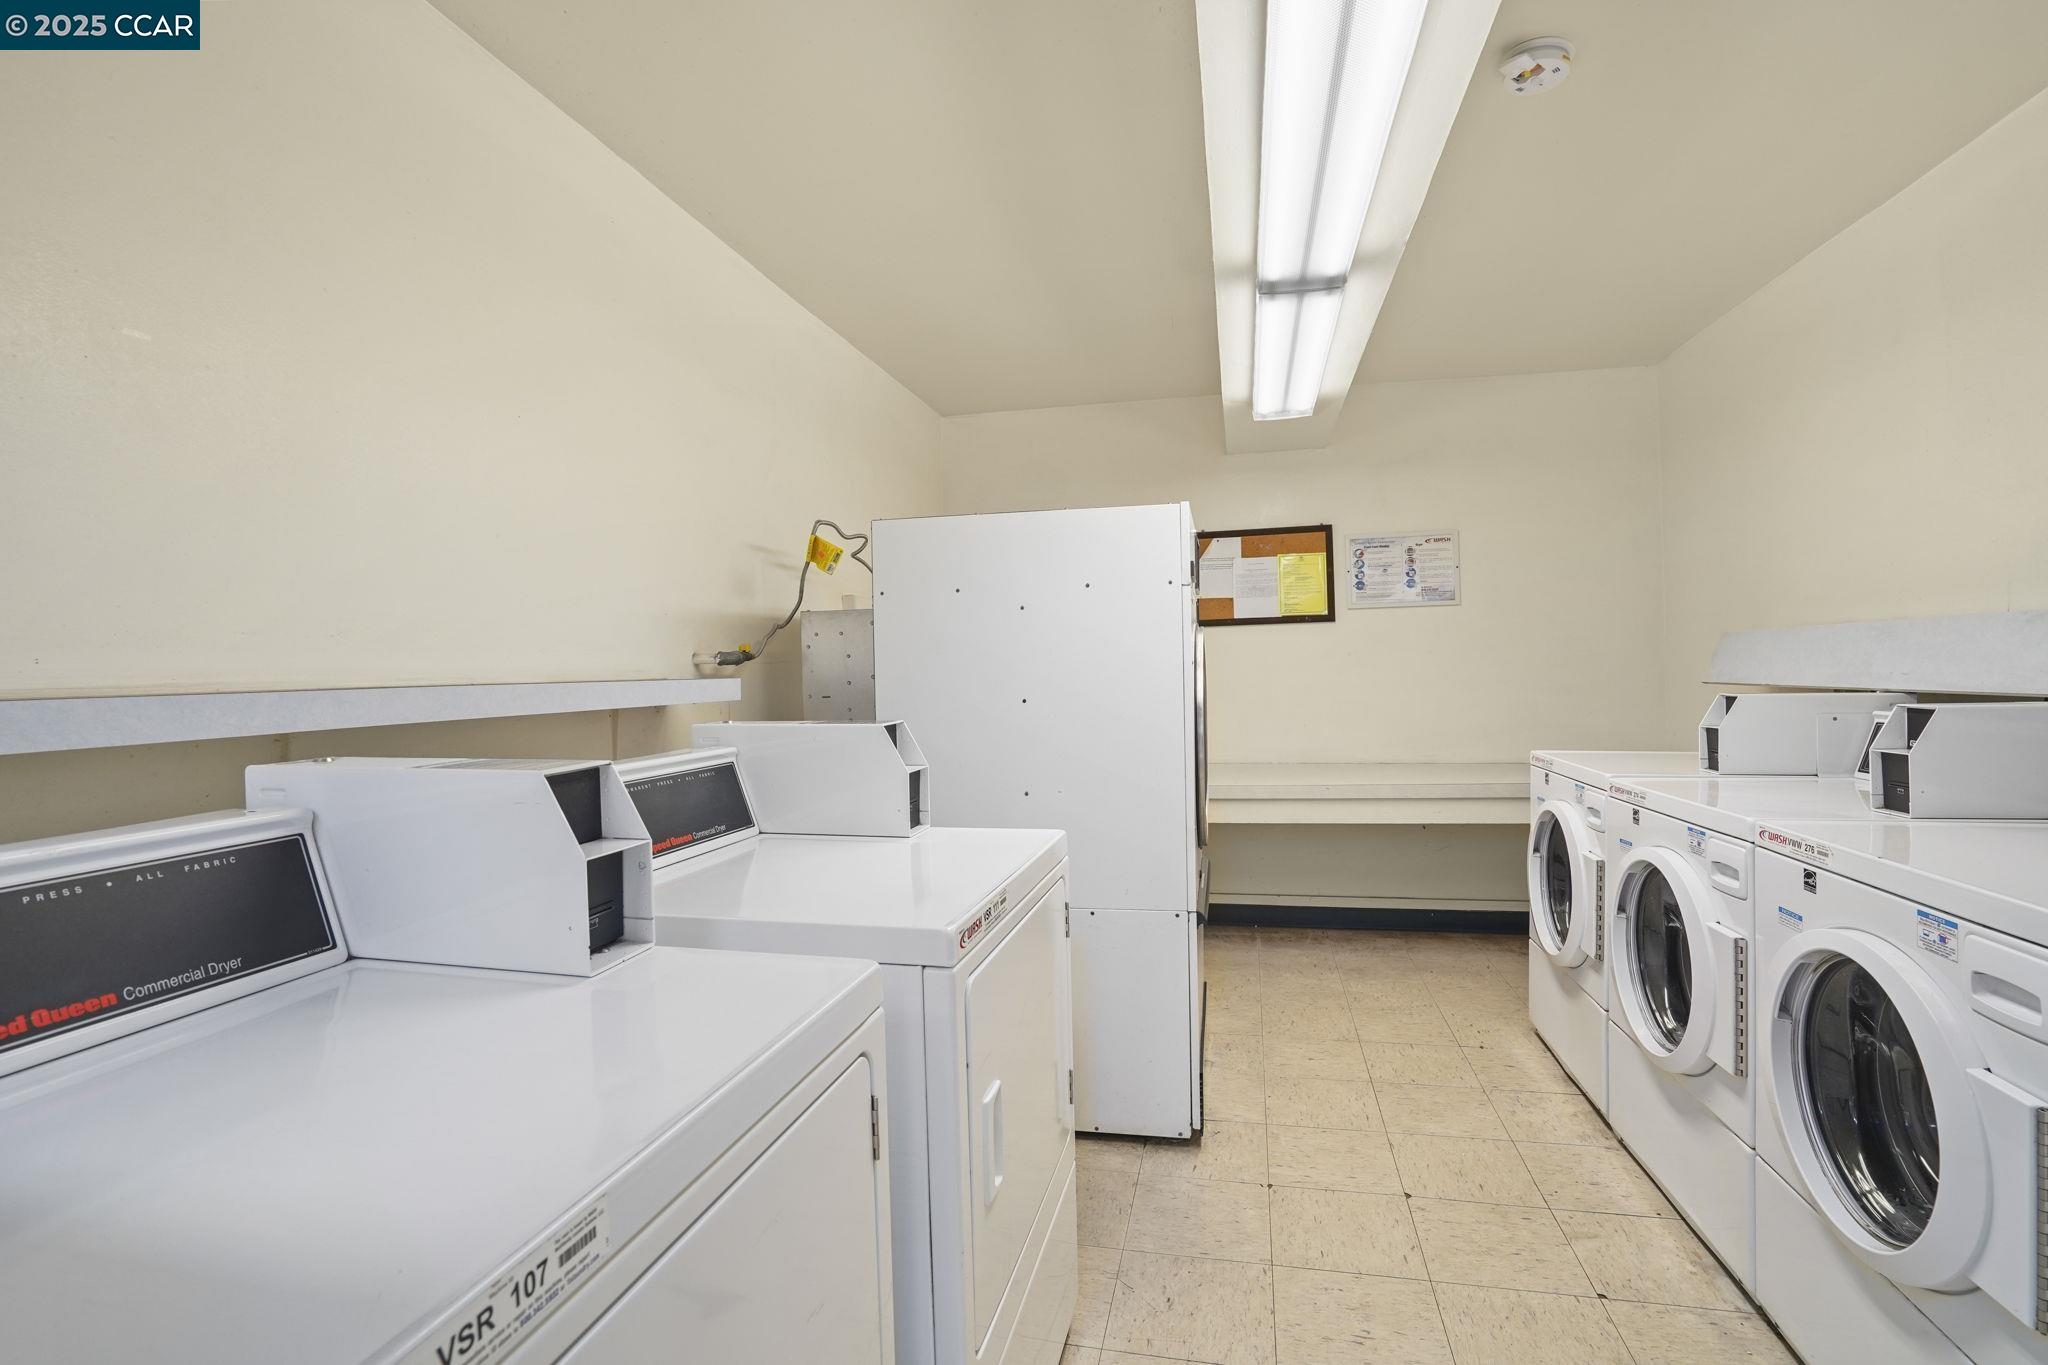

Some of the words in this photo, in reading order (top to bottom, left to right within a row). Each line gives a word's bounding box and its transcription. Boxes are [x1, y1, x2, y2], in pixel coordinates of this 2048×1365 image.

[652, 838, 672, 854] peed
[670, 833, 693, 846] Queen
[692, 826, 716, 840] Commercial
[715, 824, 727, 833] Dryer
[1767, 831, 1788, 846] WASH
[22, 885, 84, 905] PRESS
[135, 870, 165, 882] ALL
[183, 855, 238, 873] FABRIC
[31, 991, 118, 1028] Queen
[123, 967, 206, 1001] Commercial
[207, 956, 243, 979] Dryer
[435, 1305, 496, 1365] VSR
[510, 1256, 549, 1308] 107
